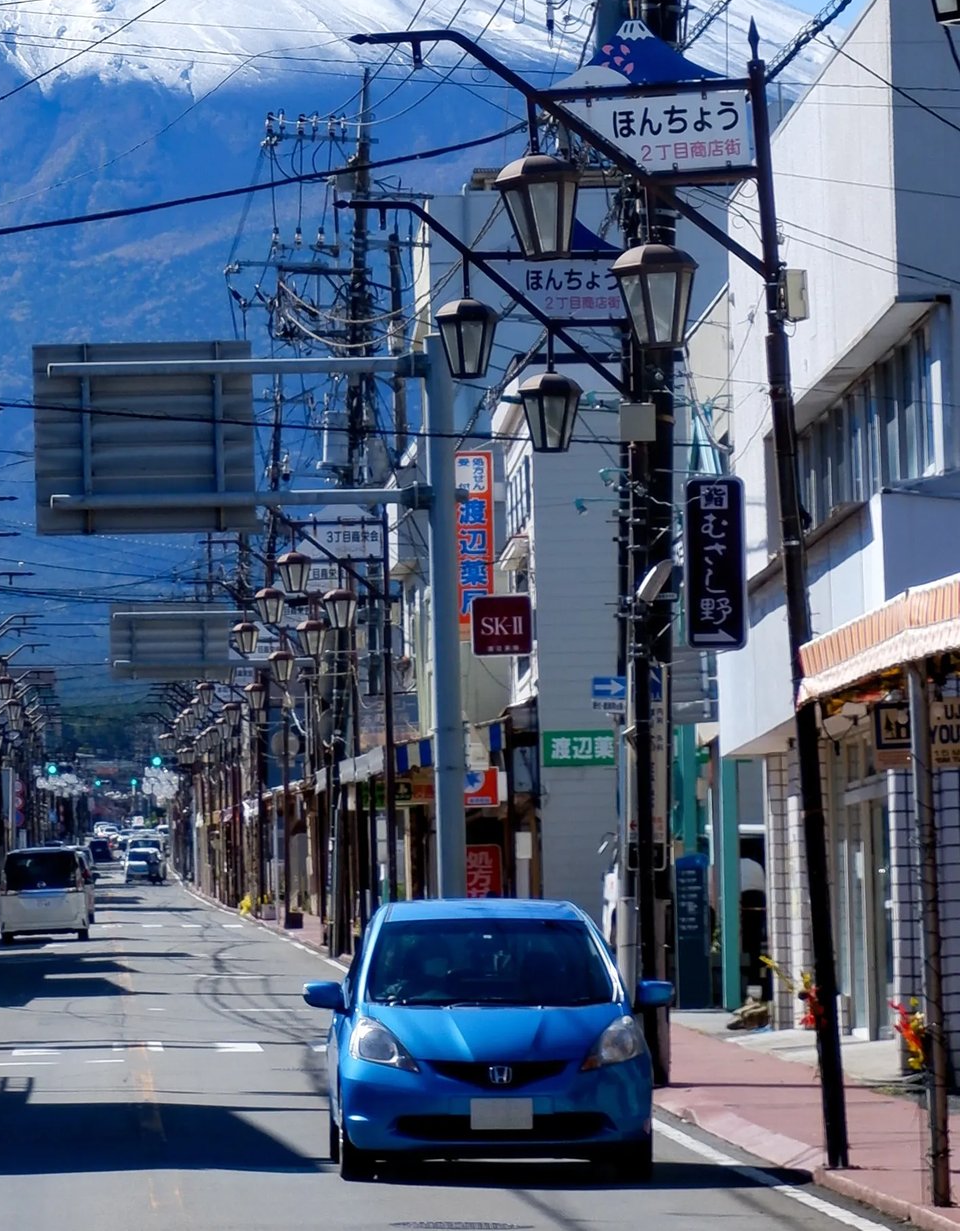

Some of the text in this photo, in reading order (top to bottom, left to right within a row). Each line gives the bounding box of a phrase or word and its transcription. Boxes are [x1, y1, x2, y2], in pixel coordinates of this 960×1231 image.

[612, 101, 739, 139] ほんちょう
[640, 138, 741, 162] 2丁目商店街
[525, 268, 620, 291] ほんちょう
[544, 295, 621, 310] 2丁目商店街
